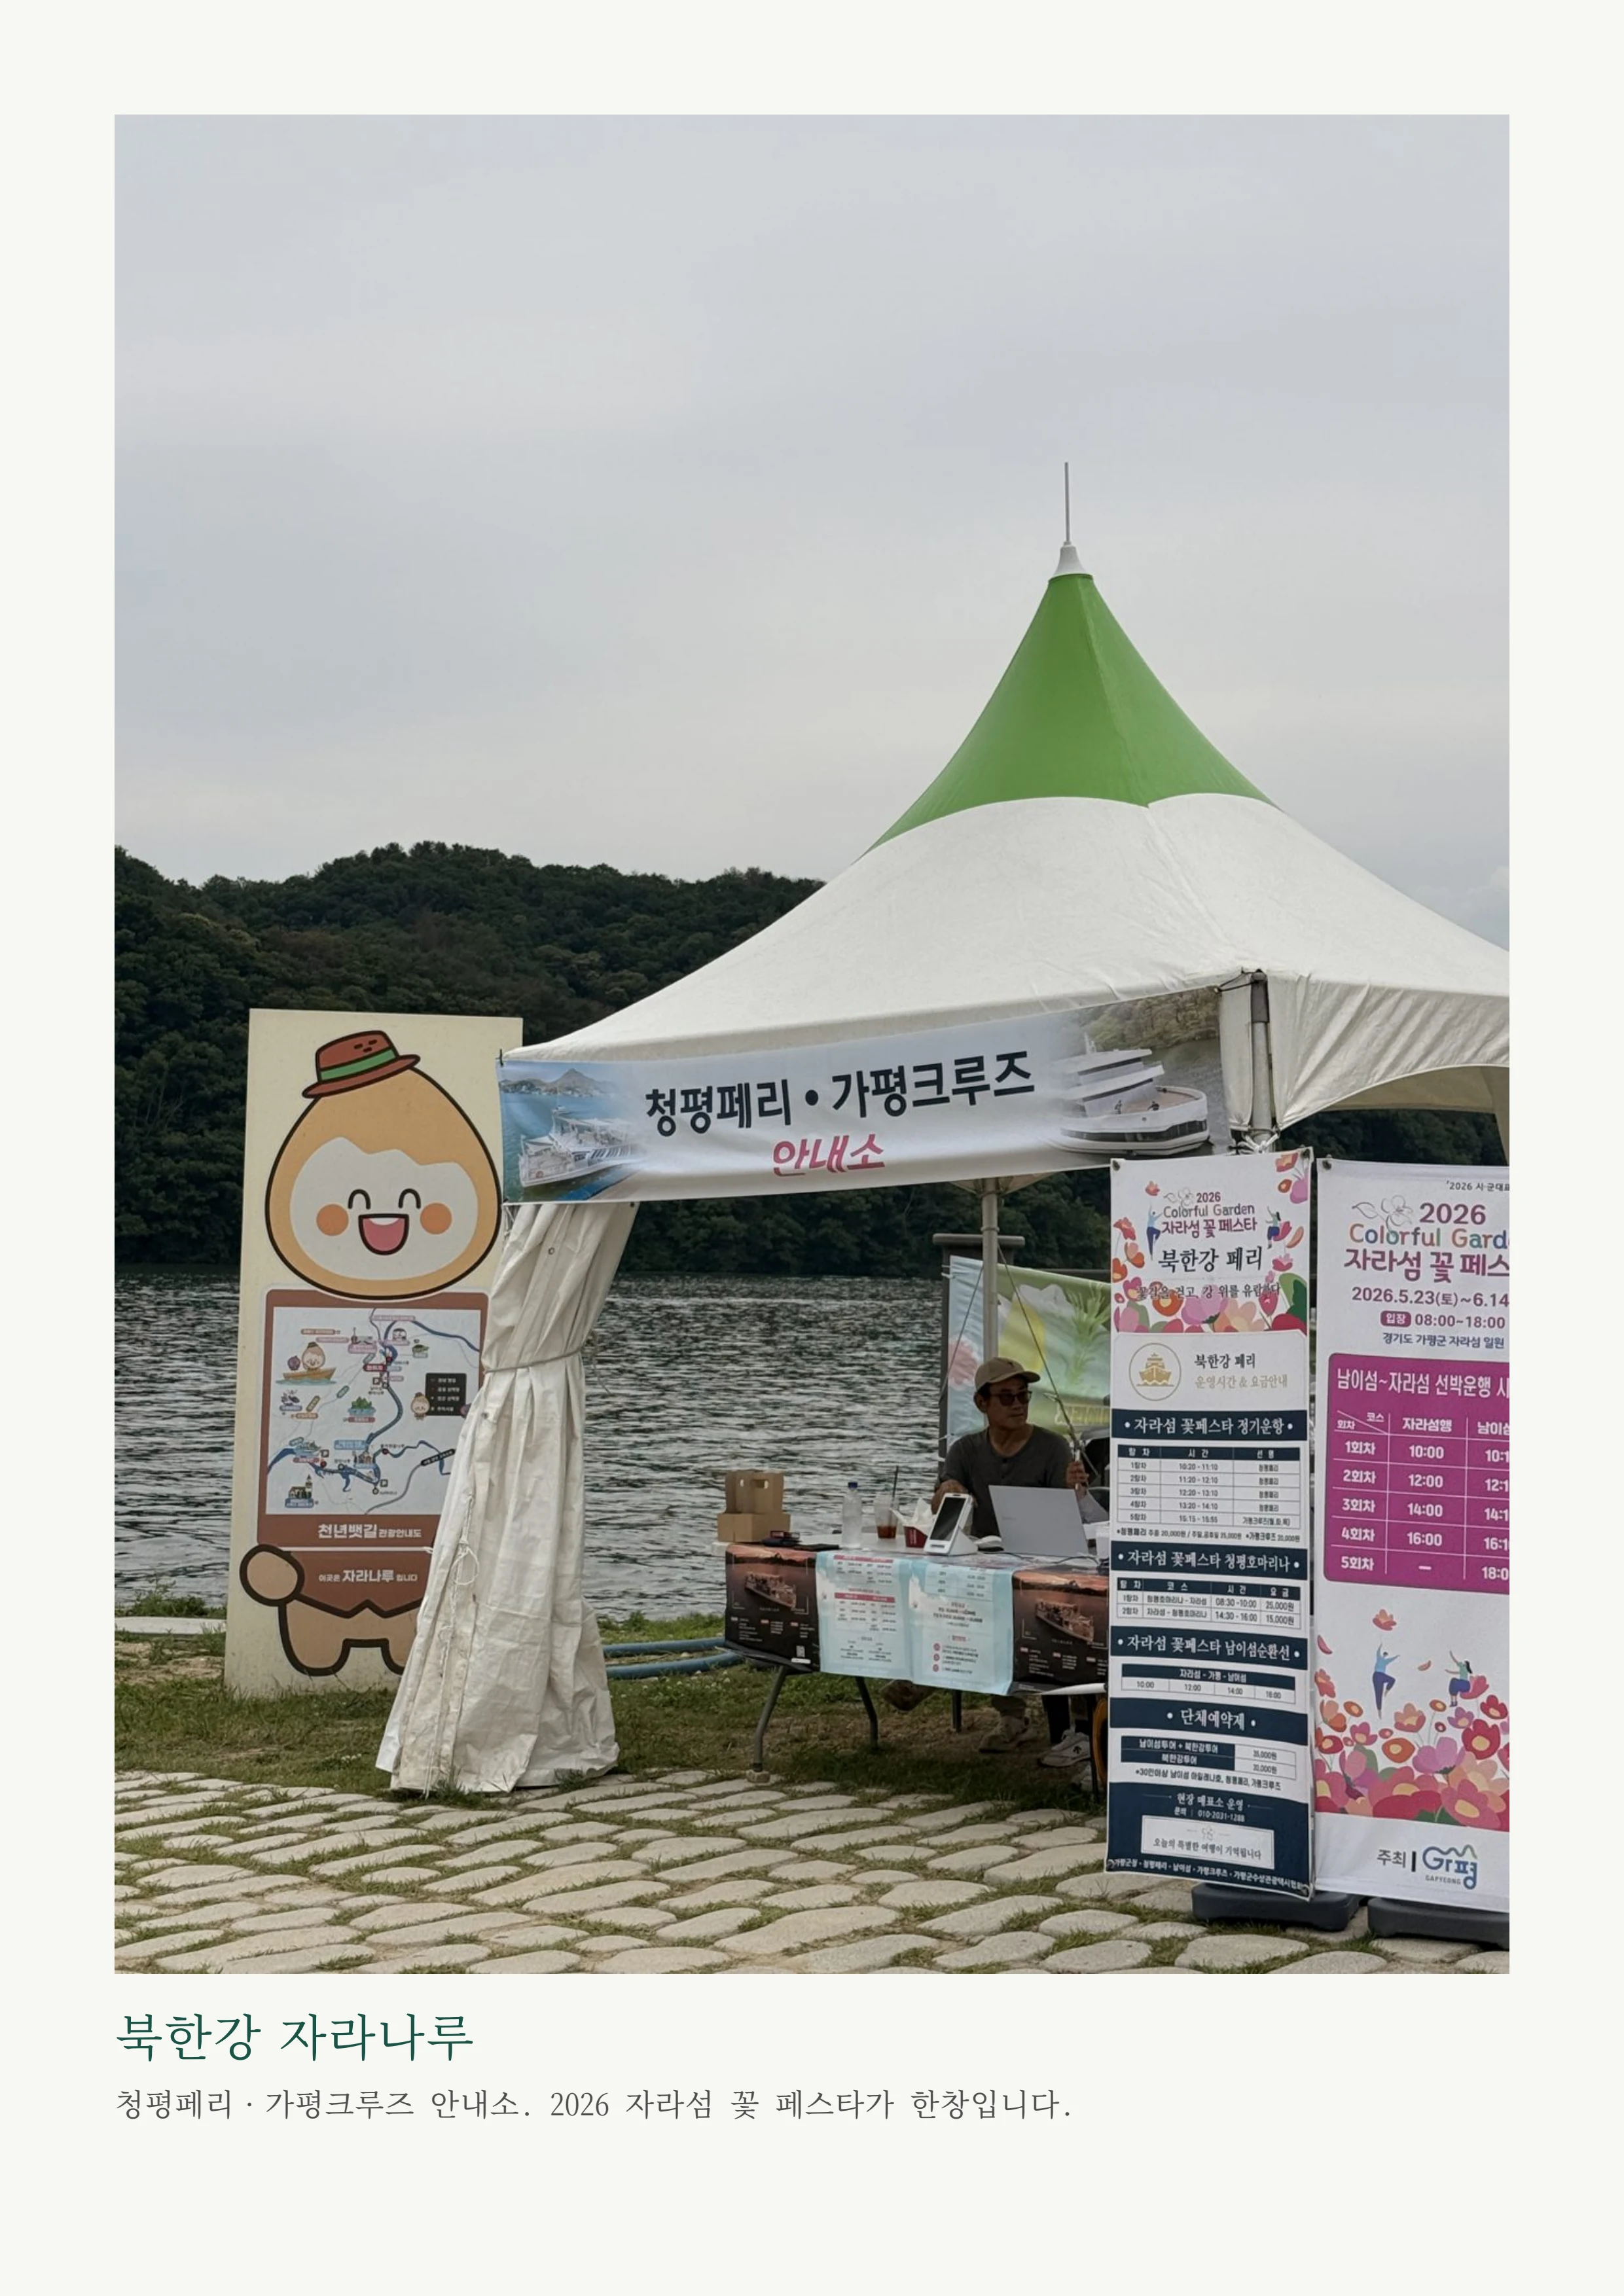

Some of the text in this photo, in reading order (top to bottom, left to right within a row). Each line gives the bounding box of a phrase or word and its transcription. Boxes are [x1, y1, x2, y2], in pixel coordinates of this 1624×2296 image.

[645, 1050, 1036, 1138] 청평페리 가평크루즈
[773, 1134, 885, 1177] 안내소
[1197, 1192, 1221, 1202] 2026
[1163, 1204, 1255, 1219] Colorful Garden
[1419, 1202, 1486, 1225] 2026
[1161, 1218, 1257, 1238] 자라섬 꽃 페스타
[1350, 1223, 1509, 1249] Colorful Gard
[1159, 1246, 1263, 1273] 북한강 페리
[1344, 1249, 1421, 1282] 자라섬
[1430, 1252, 1454, 1283] 꽃
[1201, 1285, 1212, 1298] 강
[1218, 1285, 1239, 1298] 위를
[1243, 1283, 1281, 1297] 유람하다
[1352, 1286, 1509, 1308] 2026.5.23(토)~6.14
[1386, 1313, 1506, 1329] 입장 08:00~18:00
[1383, 1333, 1505, 1349] 경기도 가평군 자라섬 일원
[1194, 1354, 1255, 1369] 북한강 페리
[1195, 1374, 1288, 1389] 운영시간 & 요금안내
[1337, 1369, 1430, 1395] 남이섬~자라섬
[1435, 1374, 1490, 1399] 선박운행
[1366, 1412, 1384, 1422] 코스
[1134, 1417, 1284, 1435] 자라섬 꽃페스타 정기운항
[1337, 1420, 1356, 1430] 회차
[1402, 1418, 1452, 1432] 자라섬행
[1345, 1441, 1376, 1456] 1회차
[1409, 1444, 1444, 1460] 10:00
[1343, 1469, 1377, 1484] 2회차
[1408, 1473, 1443, 1488] 12:00
[1342, 1498, 1376, 1513] 3회차
[1407, 1503, 1443, 1518] 14:00
[318, 1523, 422, 1539] 천년뱃길 관광안내도
[1341, 1527, 1375, 1542] 4회차
[1407, 1532, 1442, 1547] 16:00
[1483, 1537, 1509, 1551] 16:1
[1127, 1550, 1291, 1572] 자라섬 꽃페스타 청평호마리나
[1341, 1556, 1375, 1571] 5회차
[318, 1569, 418, 1583] 이곳은 자라나루 입니다
[1216, 1598, 1235, 1607] 08:30
[1265, 1602, 1294, 1612] 25,000원
[1240, 1613, 1257, 1622] 16:00
[1266, 1615, 1294, 1626] 15,000원
[1127, 1634, 1291, 1661] 자라섬 꽃페스타 남이섬순환선
[1180, 1668, 1201, 1679] 자라섬
[1184, 1683, 1202, 1692] 12:00
[1227, 1687, 1243, 1695] 14:00
[1265, 1691, 1281, 1699] 16:00
[1181, 1708, 1245, 1730] 단체예약제
[1139, 1738, 1176, 1750] 남이섬투어
[1170, 1770, 1189, 1780] 남이섬
[1177, 1793, 1244, 1812] 현장 매표소 운영
[1153, 1837, 1176, 1850] 오늘의
[1177, 1840, 1199, 1851] 특별한
[1200, 1843, 1223, 1855] 여행이
[1377, 1849, 1406, 1868] 주최
